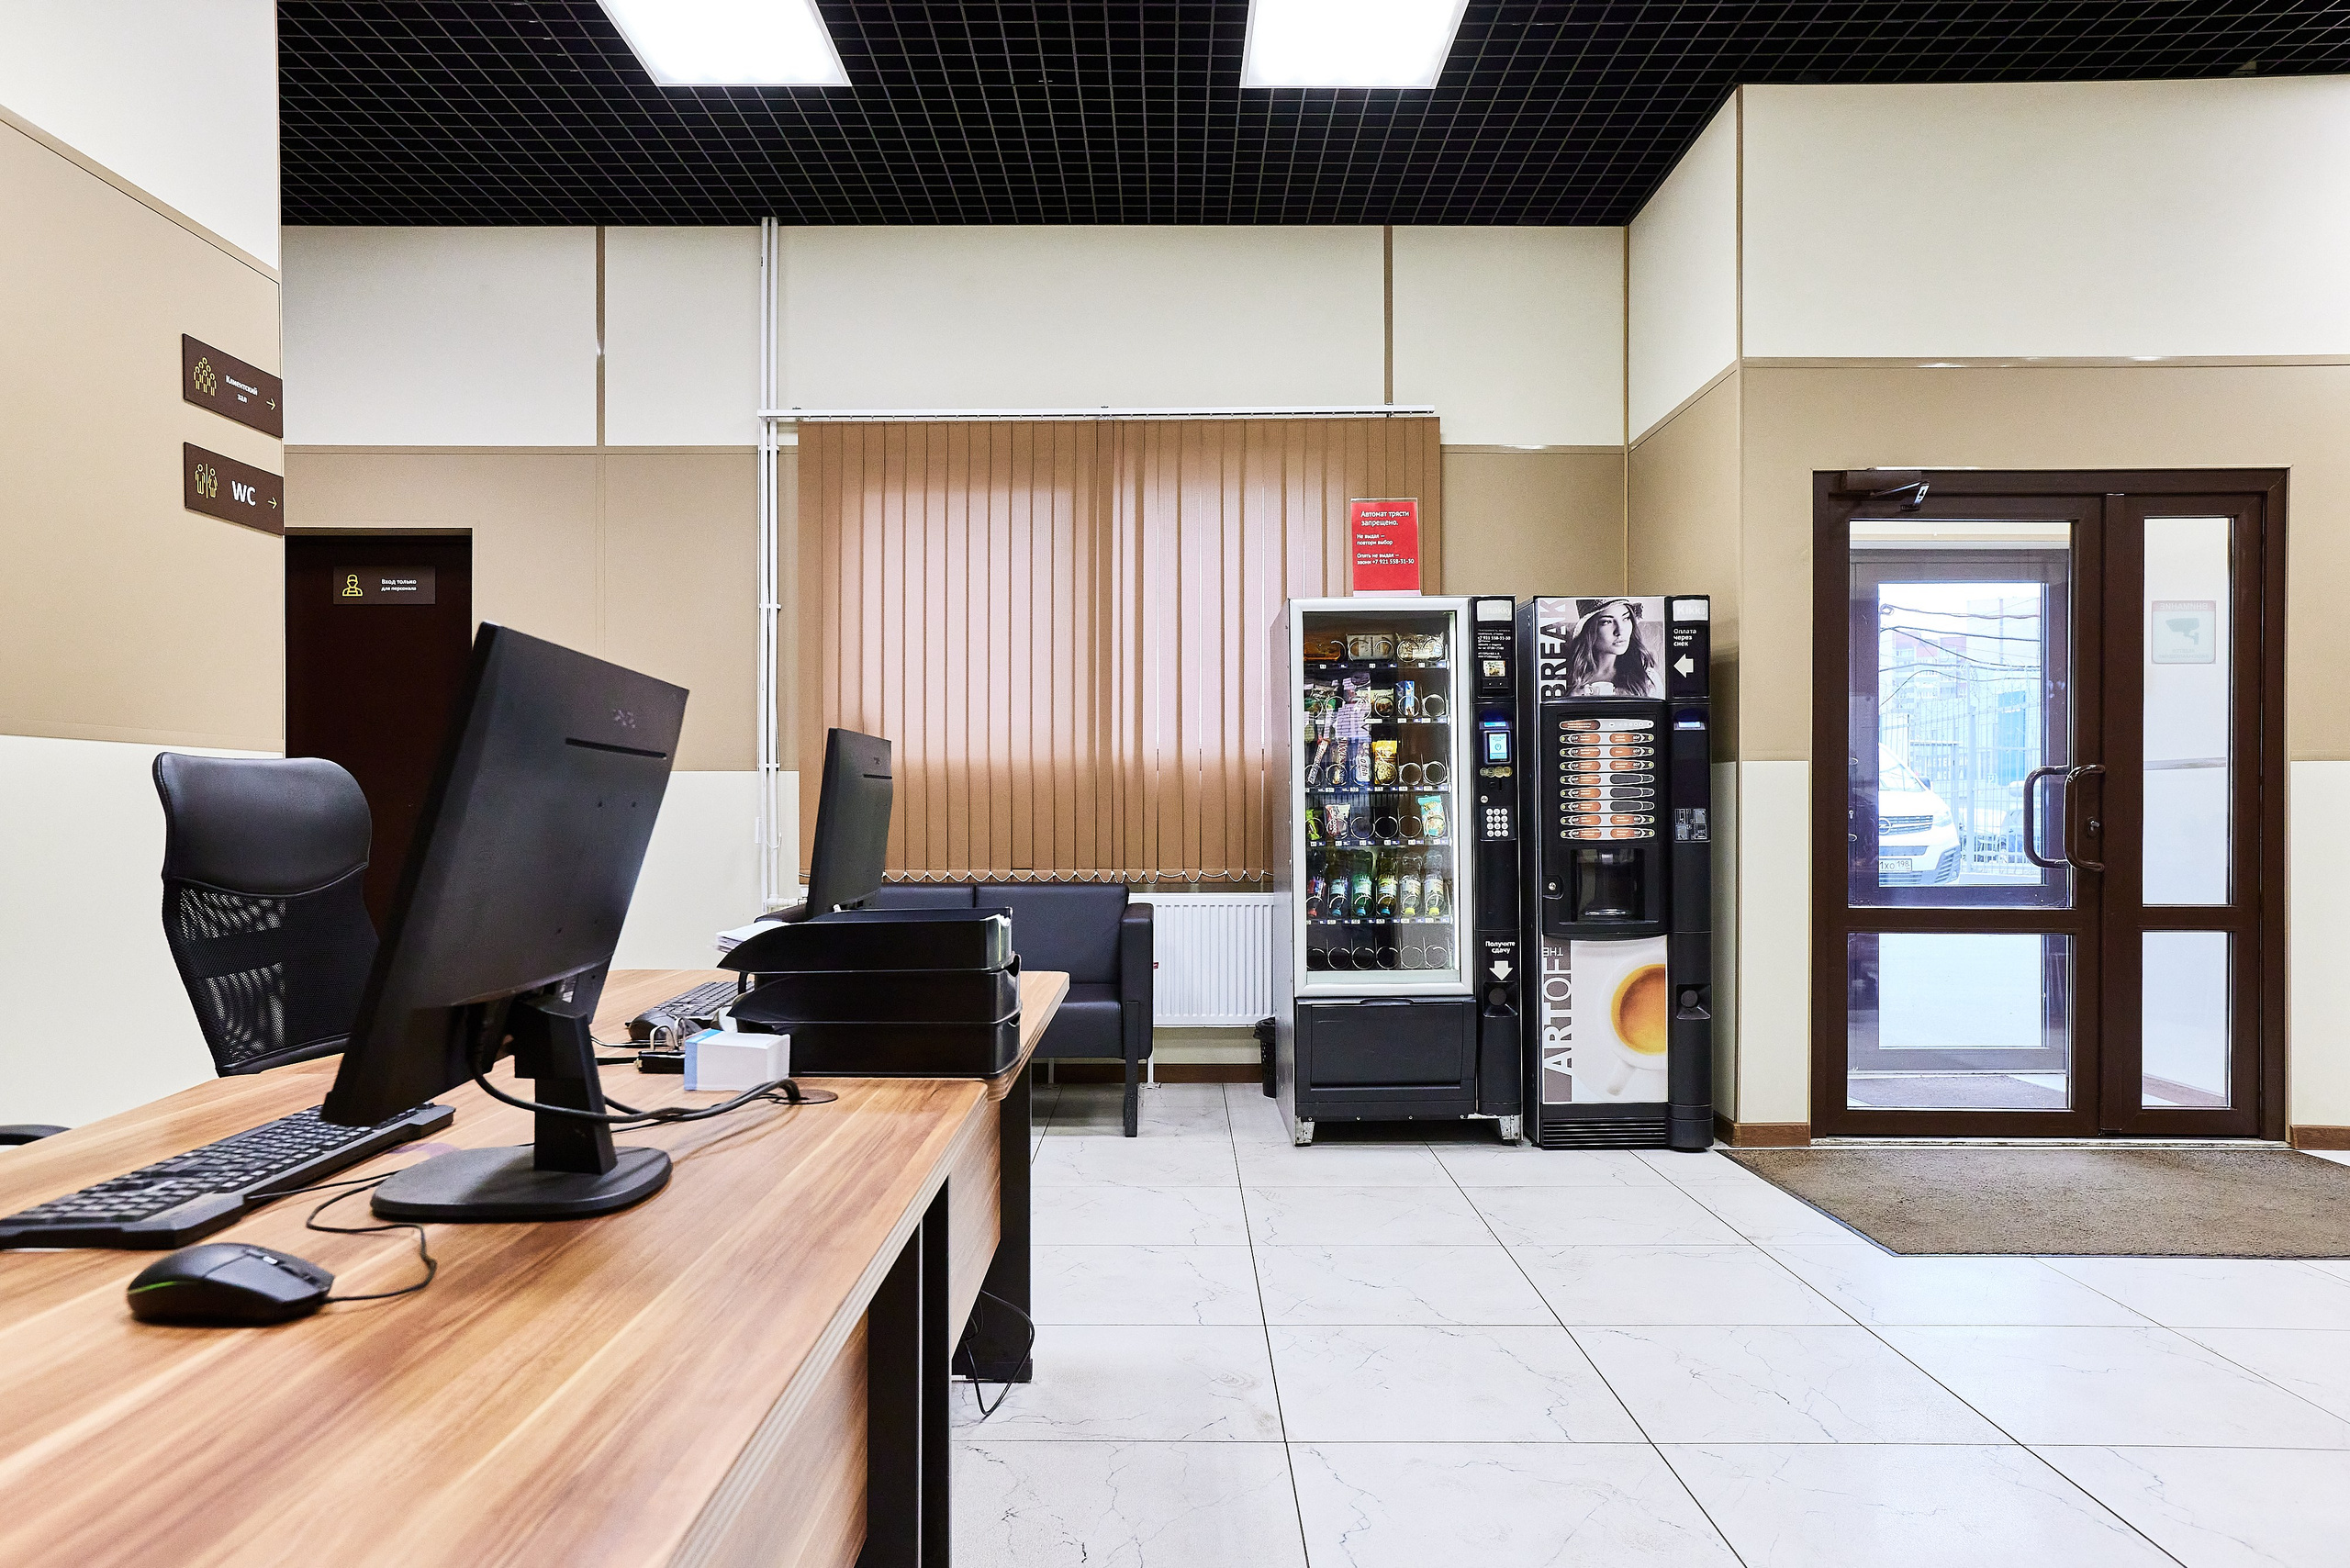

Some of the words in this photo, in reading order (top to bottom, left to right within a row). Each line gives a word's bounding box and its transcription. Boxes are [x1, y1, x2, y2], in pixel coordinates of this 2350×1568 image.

[225, 375, 258, 397] Клиентский
[237, 393, 248, 403] зал
[231, 480, 256, 506] WC
[1540, 599, 1567, 701] BREAK
[1485, 940, 1516, 948] Получите
[1543, 946, 1563, 957] THE
